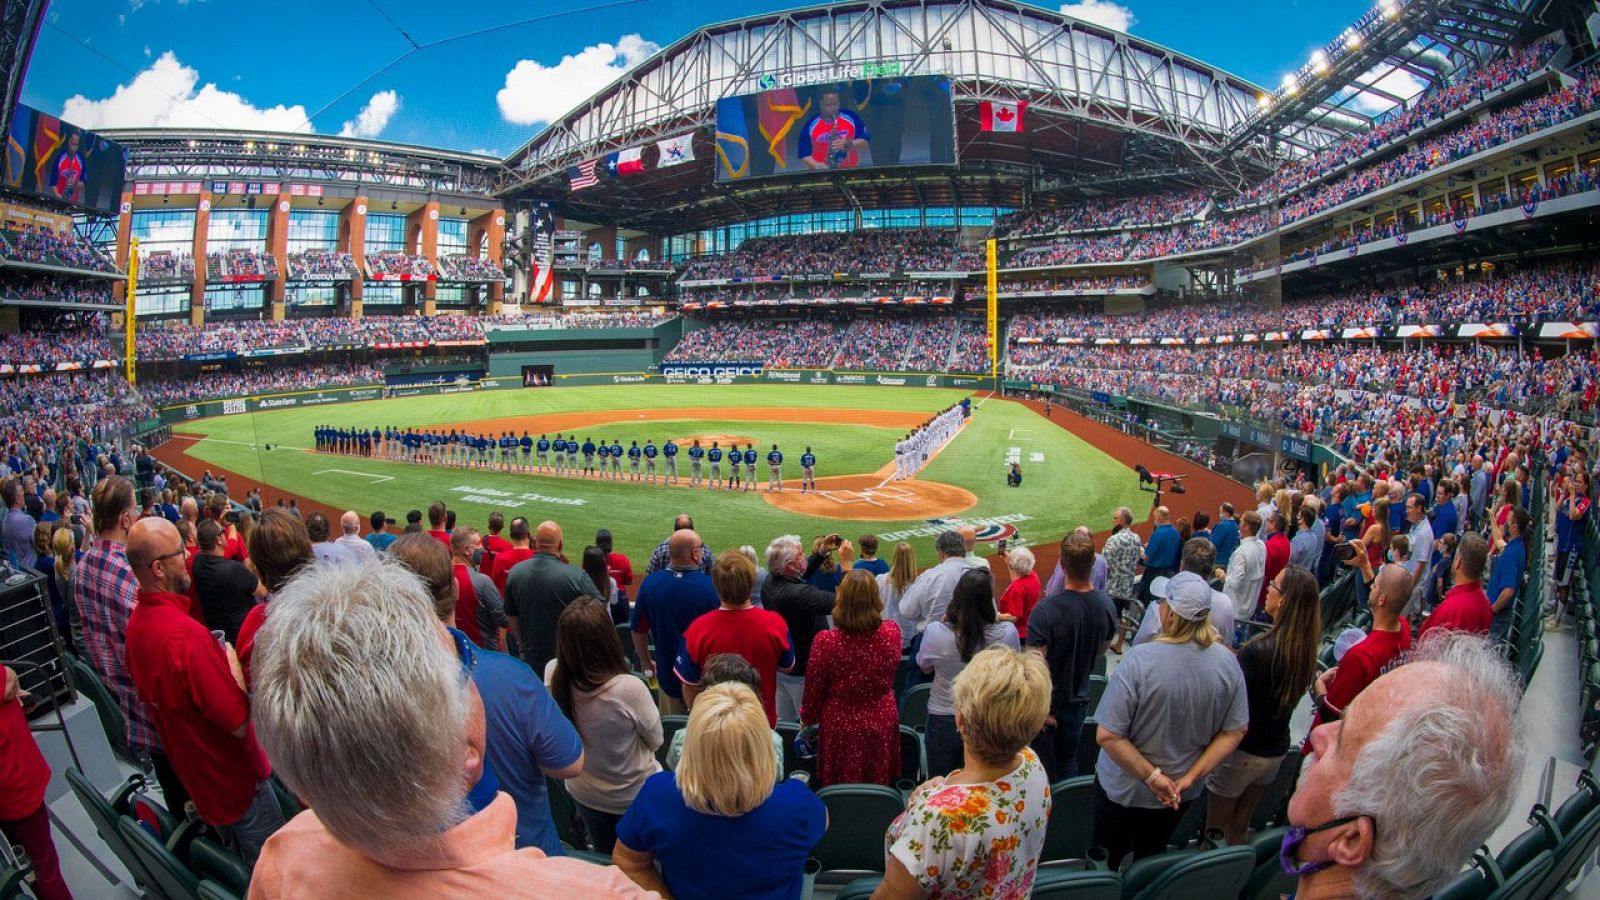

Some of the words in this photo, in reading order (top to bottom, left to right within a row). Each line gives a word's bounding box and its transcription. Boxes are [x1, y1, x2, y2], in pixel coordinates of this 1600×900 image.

[780, 72, 828, 86] Globe
[829, 64, 859, 80] Life
[863, 59, 901, 77] Field
[664, 367, 710, 377] GEICO
[713, 367, 763, 376] GEICO
[1257, 431, 1271, 447] Mitel
[1290, 440, 1308, 457] Mitel
